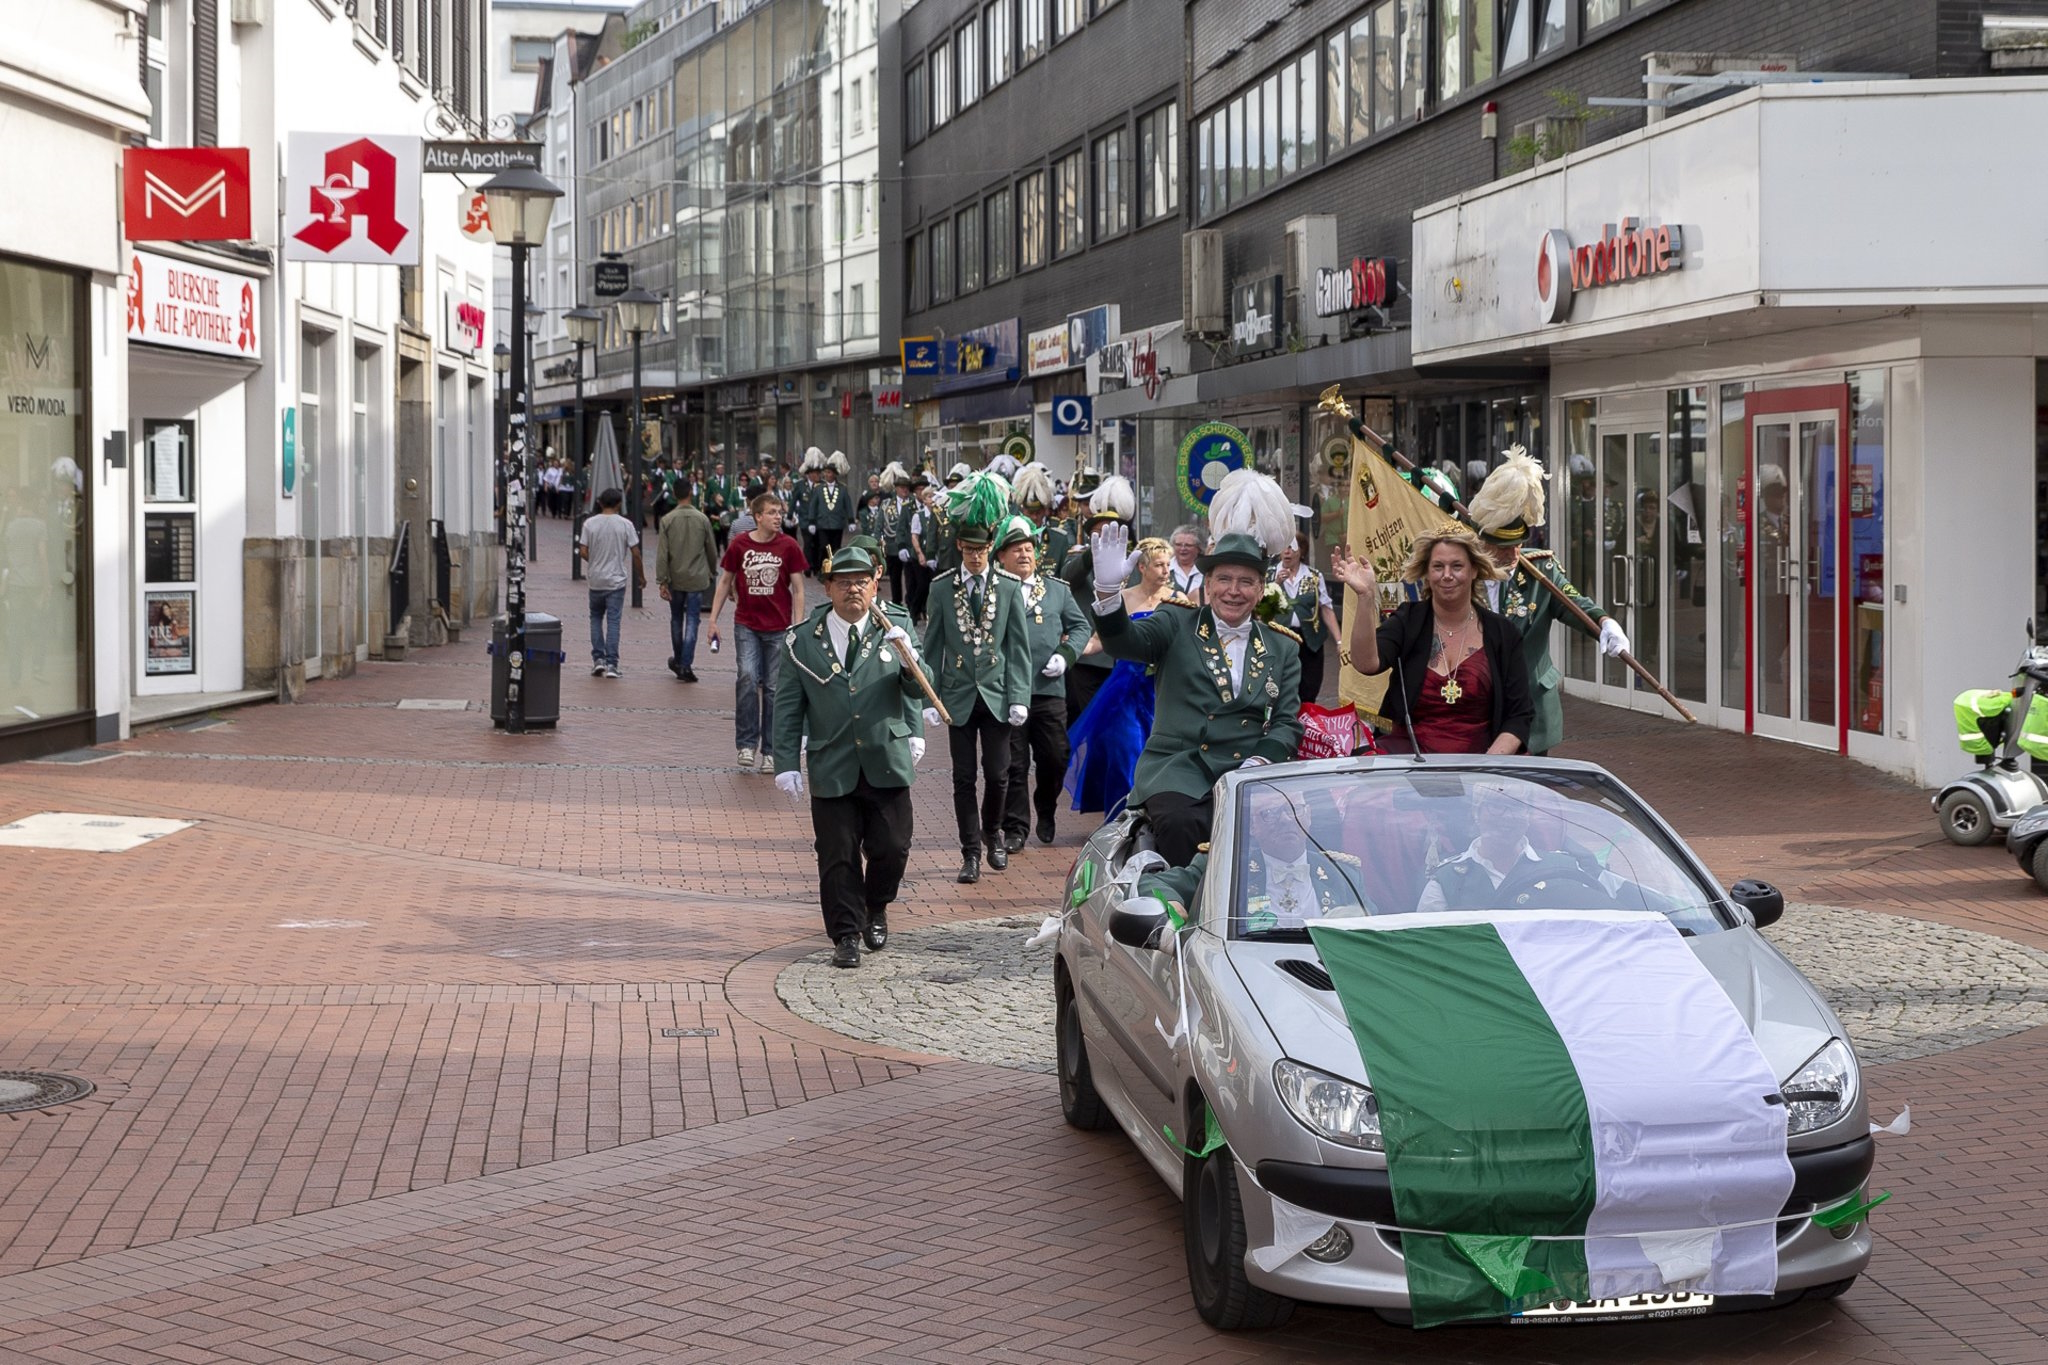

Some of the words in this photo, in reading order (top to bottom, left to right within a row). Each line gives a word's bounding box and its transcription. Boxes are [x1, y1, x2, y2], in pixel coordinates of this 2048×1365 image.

[425, 147, 459, 166] Alte
[1569, 216, 1673, 289] vodafone
[168, 269, 219, 308] BUERSCHE
[1315, 256, 1386, 317] GameStop
[154, 302, 178, 335] ALTE
[182, 308, 232, 344] APOTHEKE
[8, 395, 35, 415] VERO
[37, 398, 66, 417] MODA
[742, 549, 782, 568] Eagles
